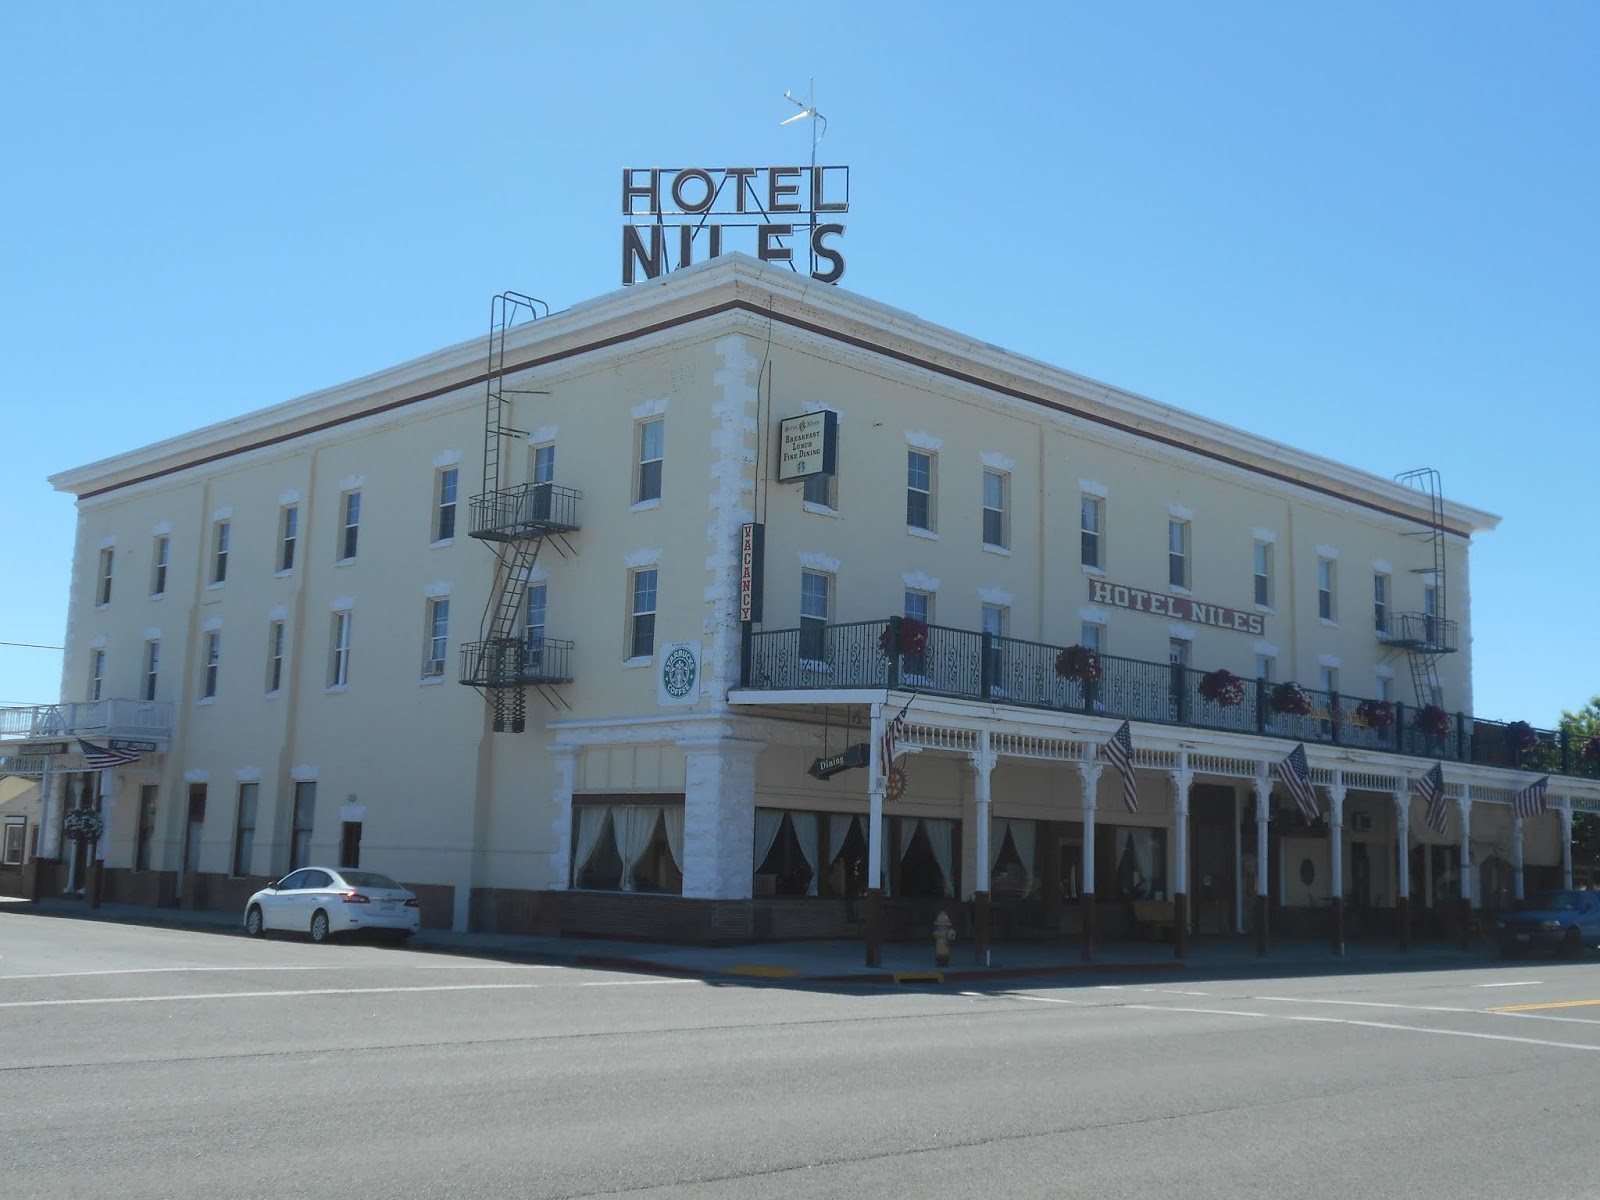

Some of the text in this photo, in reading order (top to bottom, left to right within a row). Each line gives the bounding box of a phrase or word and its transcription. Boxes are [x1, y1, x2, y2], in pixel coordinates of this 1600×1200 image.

[622, 166, 849, 214] HOTEL
[785, 431, 820, 444] BREAKFAST
[792, 441, 813, 451] LUNCH
[783, 449, 820, 462] FINE DINING
[742, 525, 752, 620] VACANCY
[1093, 581, 1263, 634] HOTEL NILES
[665, 649, 695, 672] STARBUCKS
[667, 683, 691, 696] COFFEE
[820, 756, 845, 771] Dining
